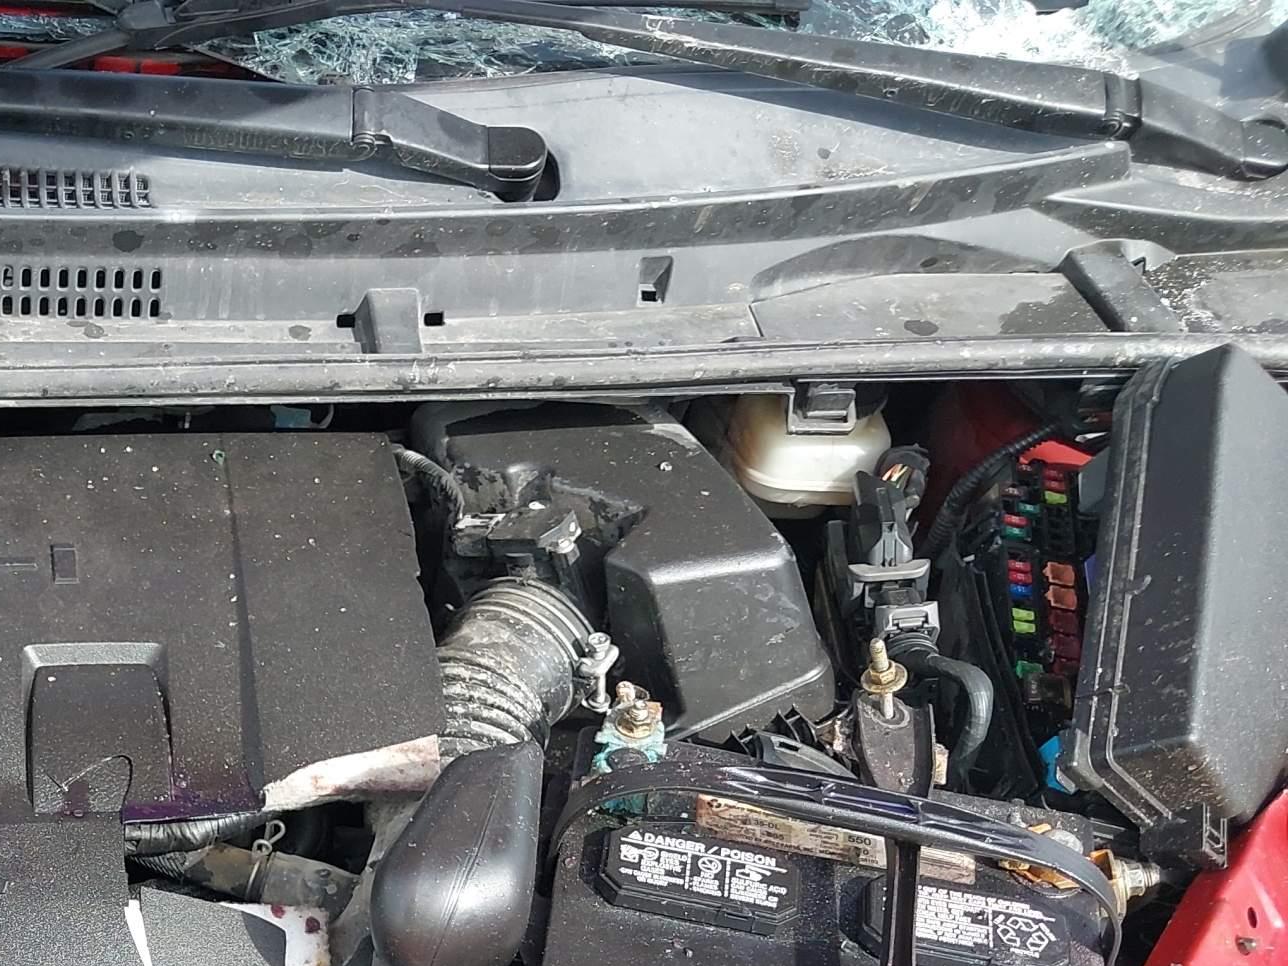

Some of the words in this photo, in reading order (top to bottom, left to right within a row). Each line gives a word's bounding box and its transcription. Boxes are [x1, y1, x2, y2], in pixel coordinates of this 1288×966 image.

[644, 832, 706, 852] DANGER
[721, 849, 777, 867] POISON
[848, 835, 872, 846] 550
